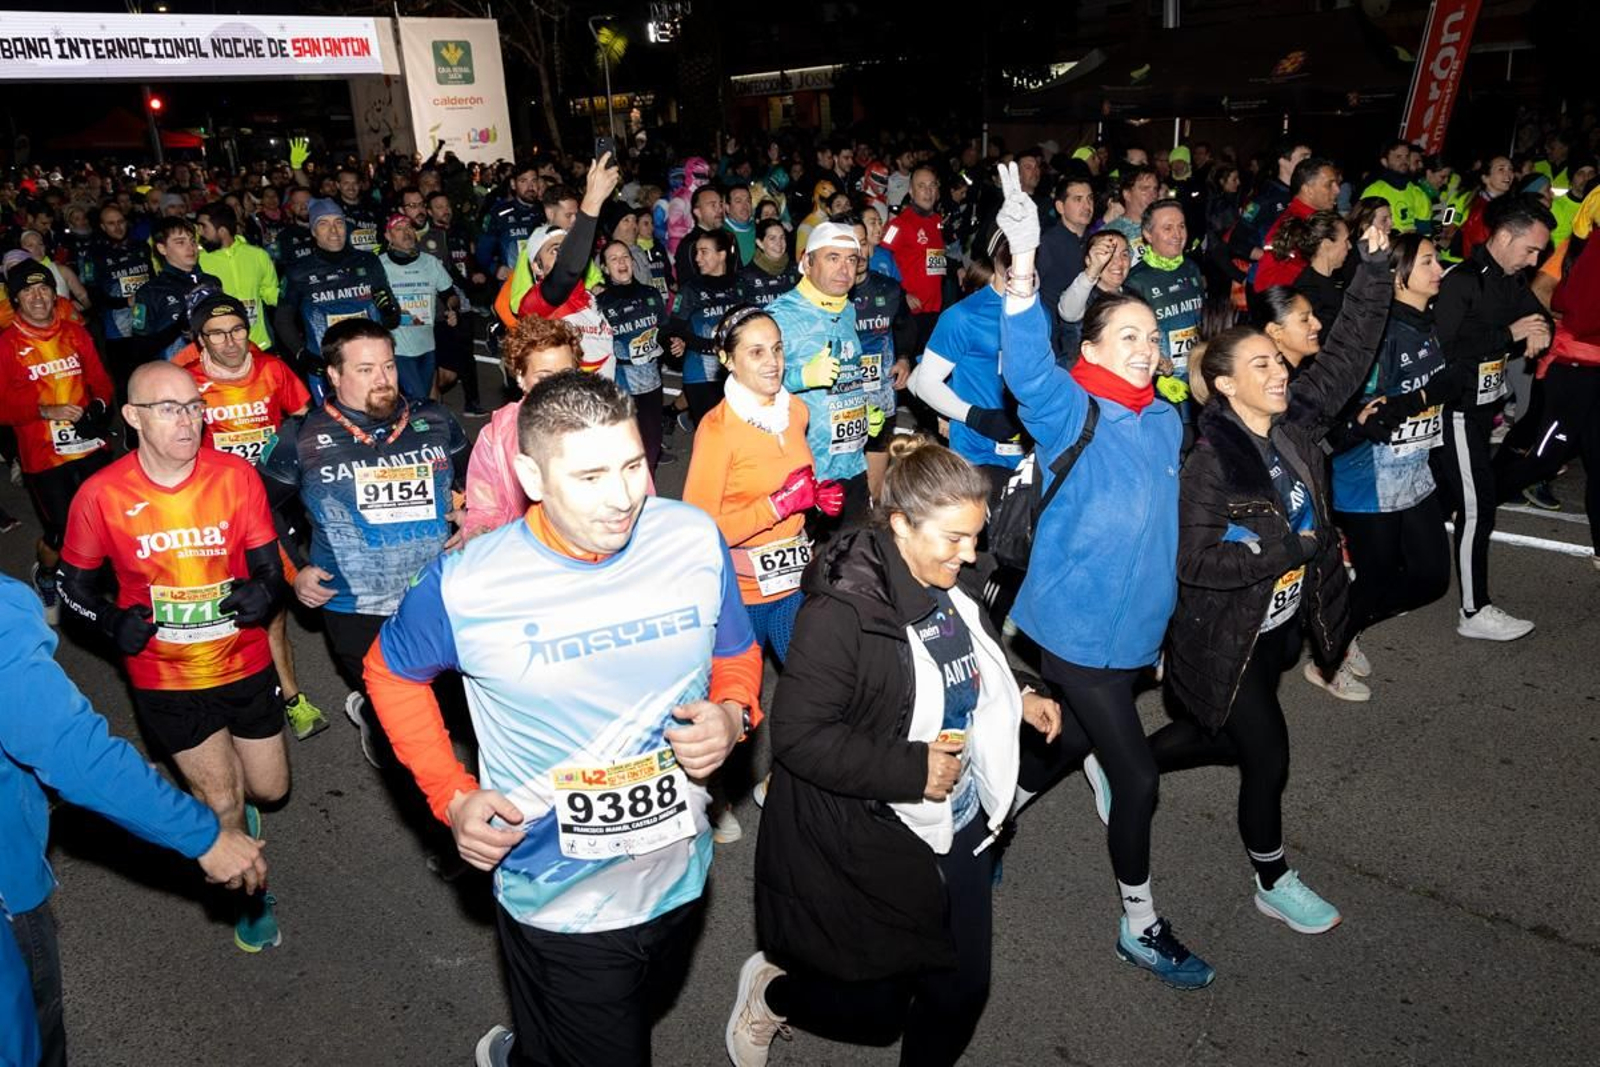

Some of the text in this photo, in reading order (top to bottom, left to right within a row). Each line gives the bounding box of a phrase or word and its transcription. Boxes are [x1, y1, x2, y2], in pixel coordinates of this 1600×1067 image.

[0, 37, 52, 60] BANA
[55, 37, 209, 60] INTERNACIONAL
[211, 37, 265, 59] NOCHE
[267, 38, 289, 58] DE
[291, 37, 322, 58] SAN
[509, 227, 528, 237] SAN
[311, 290, 337, 304] SAN
[703, 304, 724, 318] SAN
[1155, 302, 1179, 320] SAN
[612, 320, 634, 336] SAN
[1401, 372, 1430, 394] SAN
[220, 441, 267, 459] 732
[319, 460, 367, 484] SAN
[376, 443, 448, 468] ANTÓN
[363, 479, 429, 503] 9154
[177, 546, 228, 559] almansa
[759, 544, 811, 573] 6278
[170, 590, 187, 601] 42
[581, 769, 607, 786] 42
[567, 774, 677, 824] 9388
